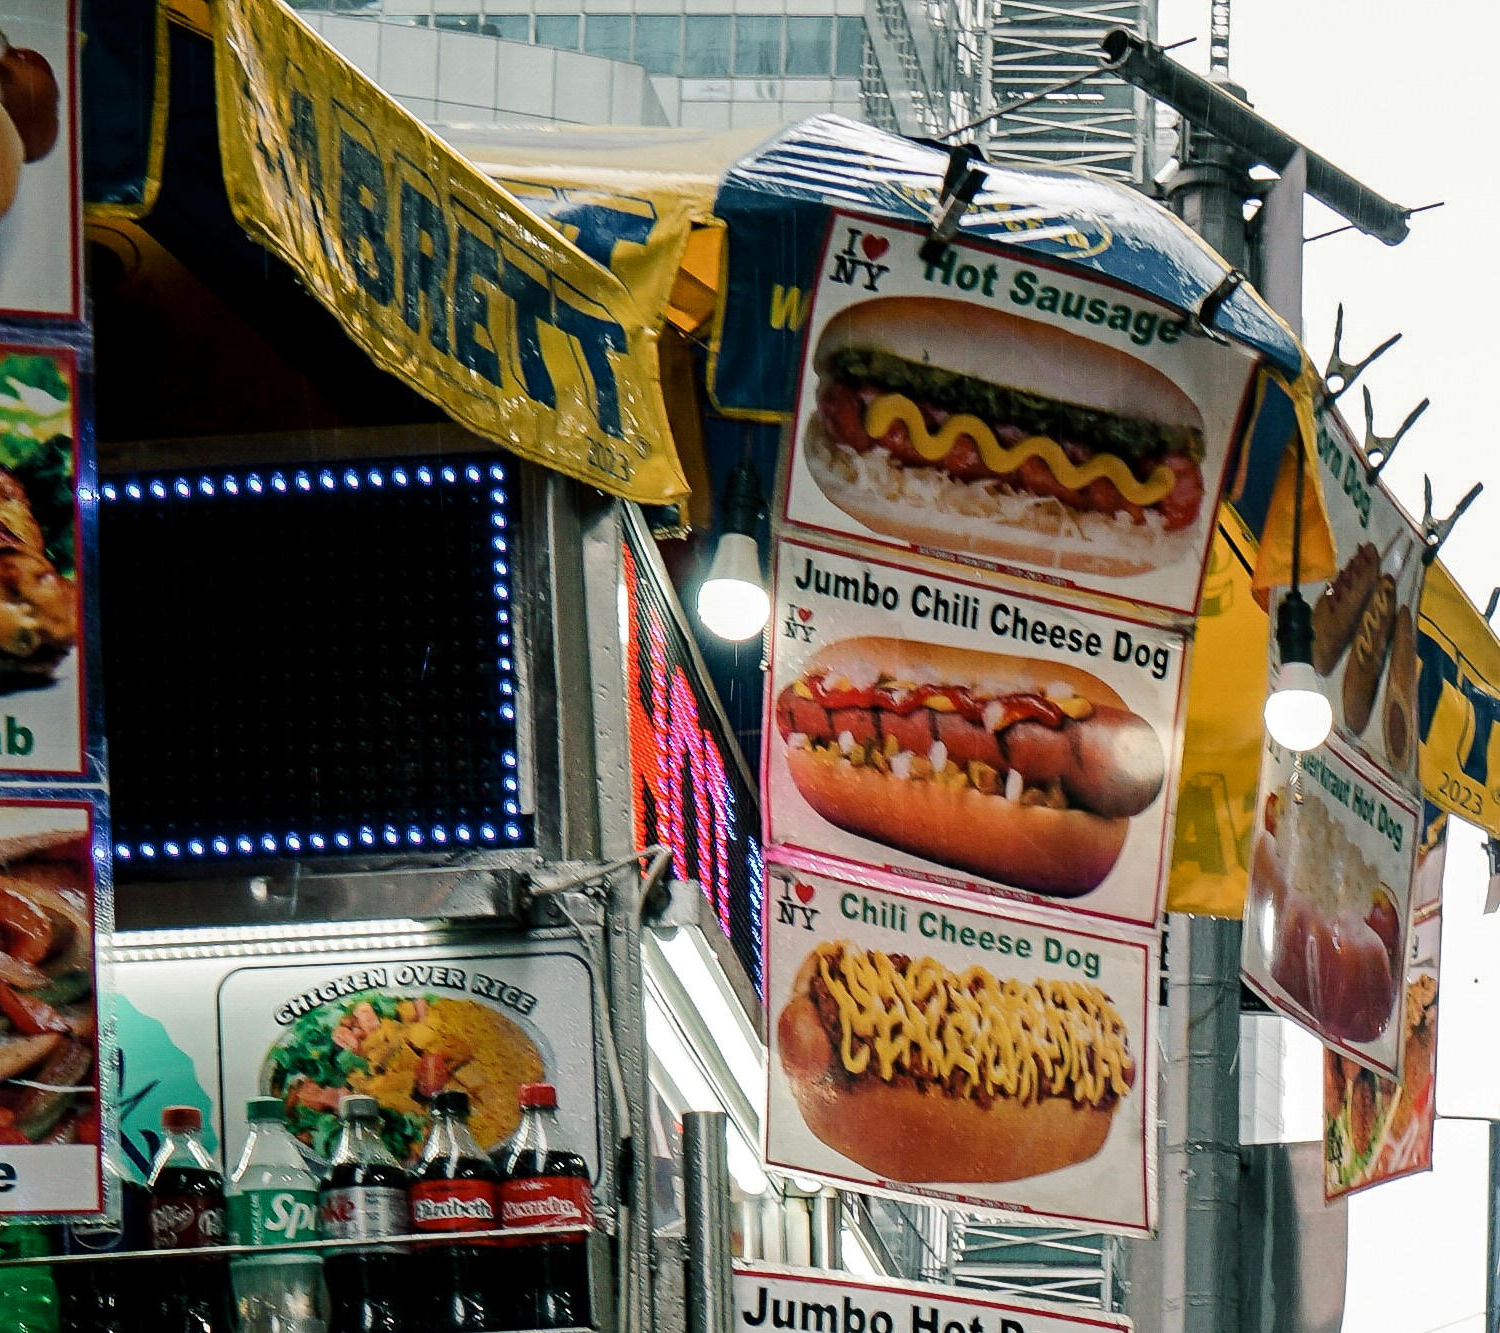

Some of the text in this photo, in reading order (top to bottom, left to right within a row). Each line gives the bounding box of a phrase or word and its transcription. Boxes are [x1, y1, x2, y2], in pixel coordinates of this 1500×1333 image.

[830, 253, 890, 293] NY
[1010, 269, 1184, 347] Sausage
[783, 619, 815, 645] NY
[795, 557, 900, 613] Jumbo
[911, 585, 978, 632] Chili
[990, 598, 1102, 659] Cheese
[1111, 632, 1170, 682] Dog
[1437, 772, 1484, 815] 2023
[776, 900, 821, 932] NY
[839, 892, 1102, 980] Chili Cheese Dog
[274, 964, 537, 1028] CHICKEN OVER RICE
